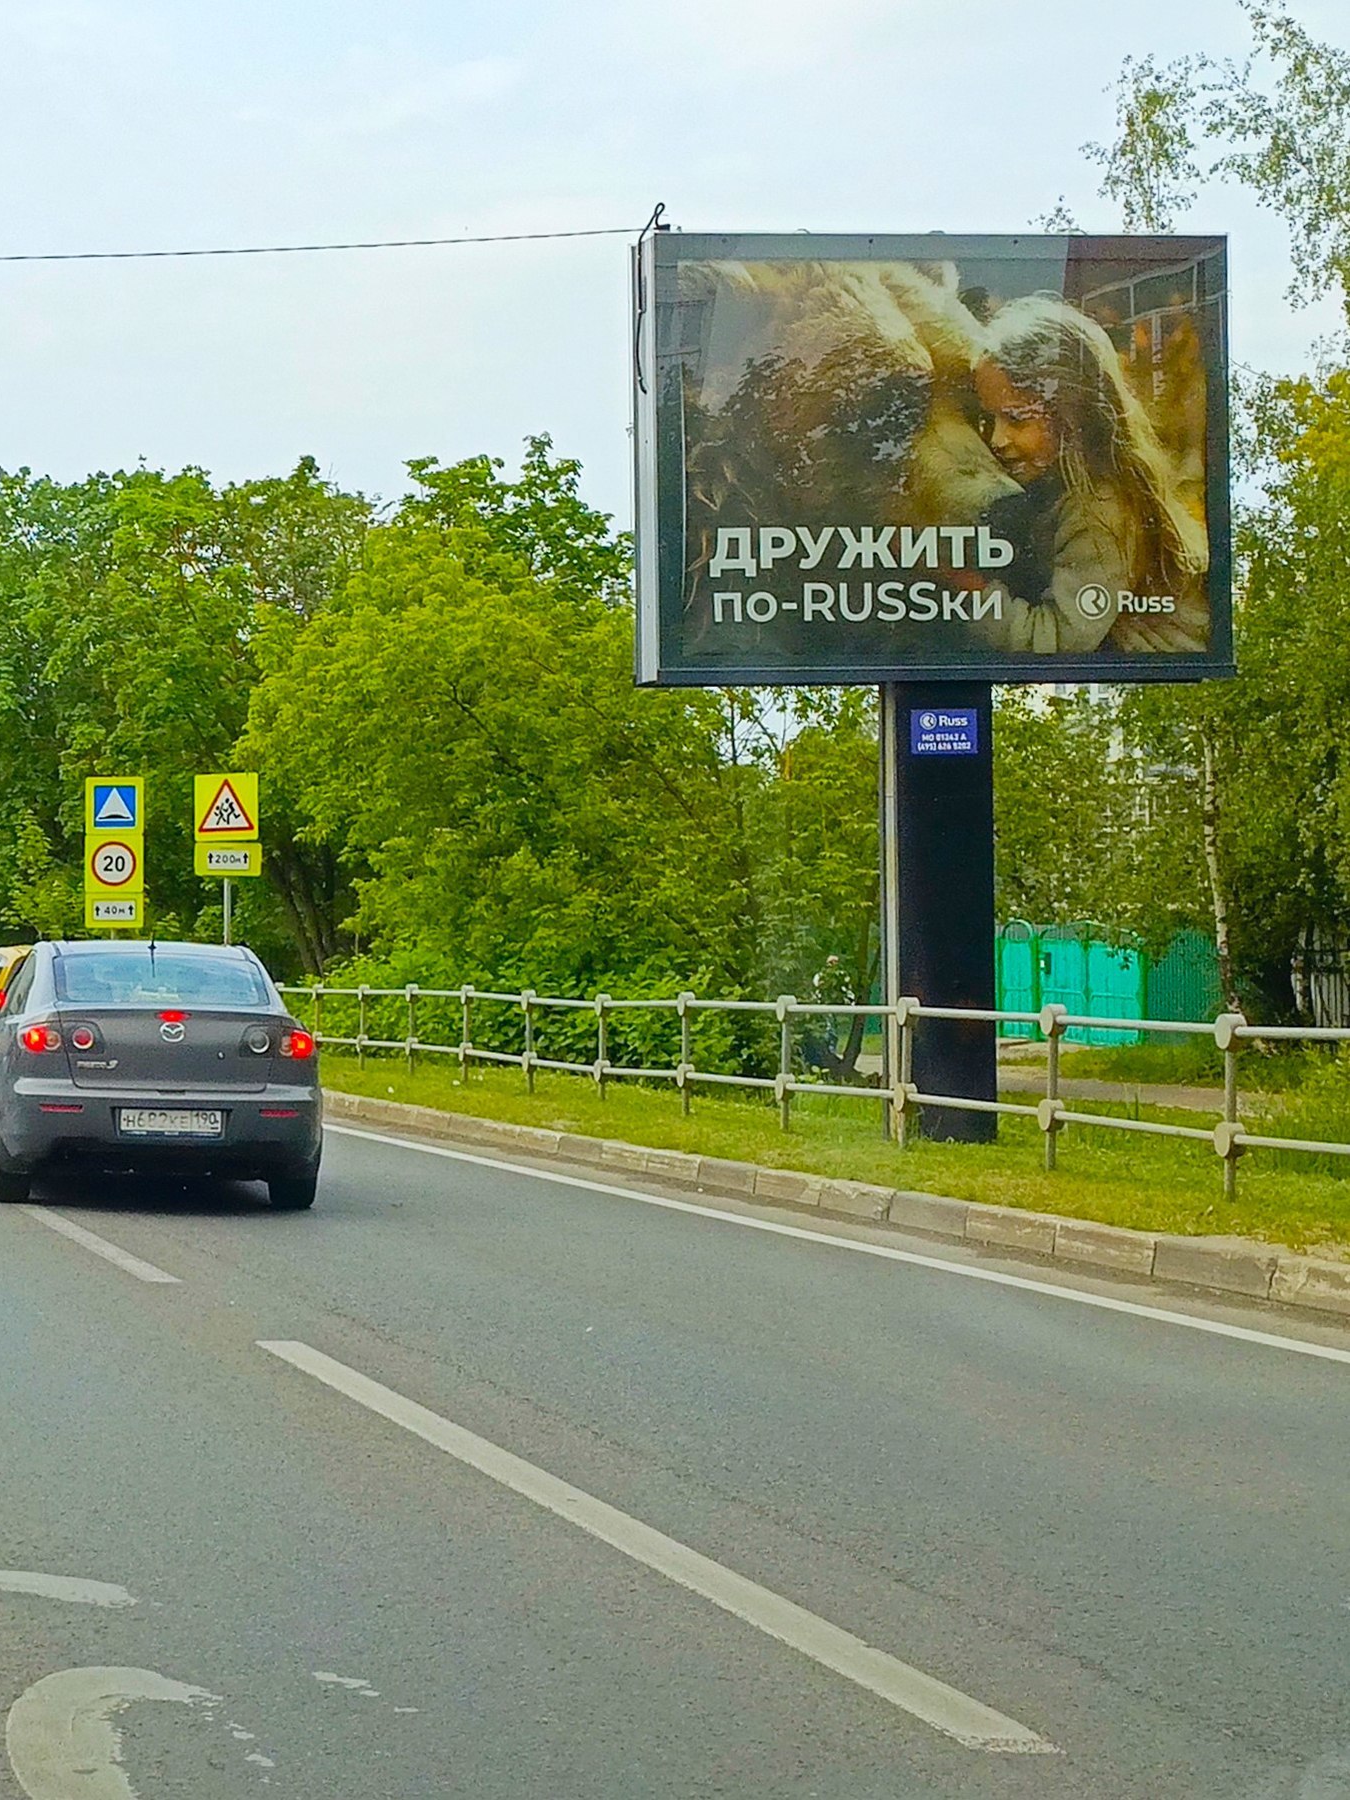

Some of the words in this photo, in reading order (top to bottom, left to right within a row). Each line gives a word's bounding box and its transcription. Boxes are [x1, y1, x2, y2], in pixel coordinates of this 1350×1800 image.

[709, 526, 1014, 577] ДРУЖИТЬ
[713, 581, 1003, 622] по-RUSSки
[1117, 590, 1176, 613] Russ
[938, 715, 969, 727] Russ
[103, 855, 126, 872] 20
